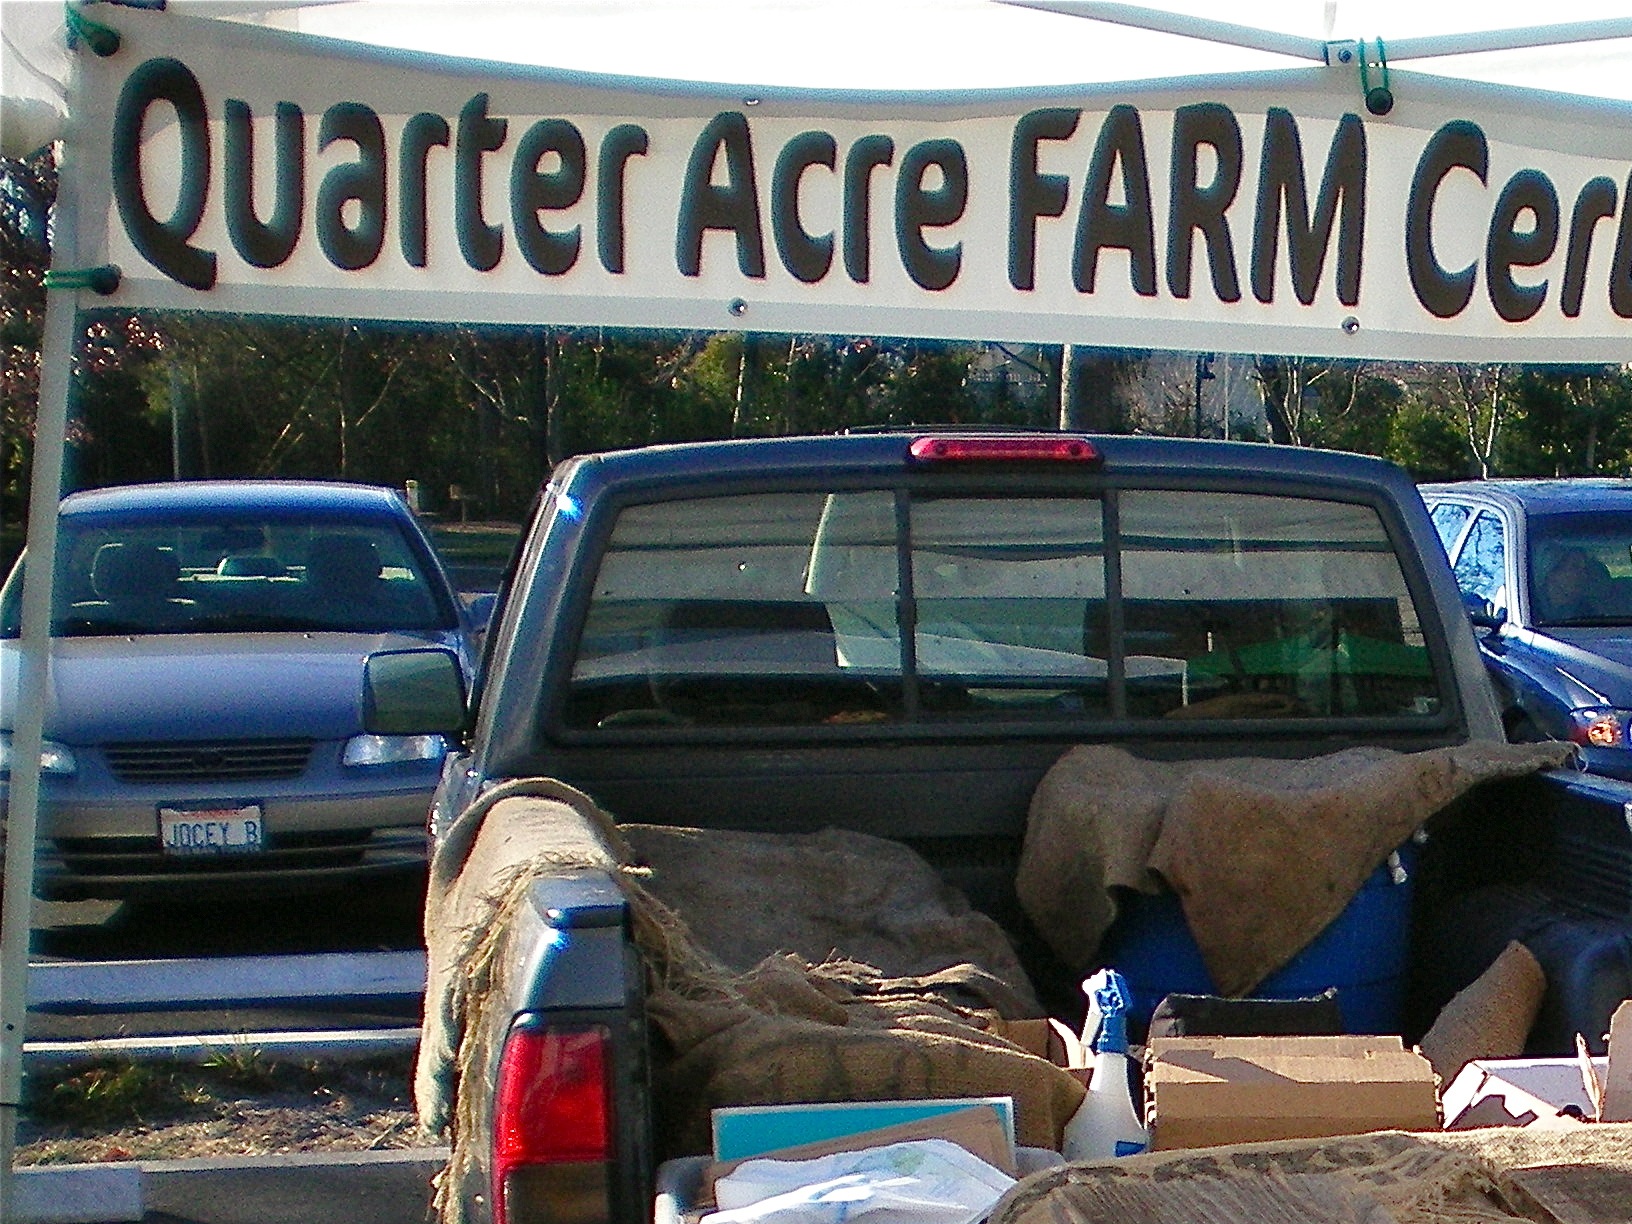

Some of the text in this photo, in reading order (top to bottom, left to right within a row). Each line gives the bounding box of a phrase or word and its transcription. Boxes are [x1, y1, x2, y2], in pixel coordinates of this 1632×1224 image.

[112, 56, 648, 290] Quarter
[676, 110, 968, 291] Acre
[1008, 102, 1367, 307] FARM
